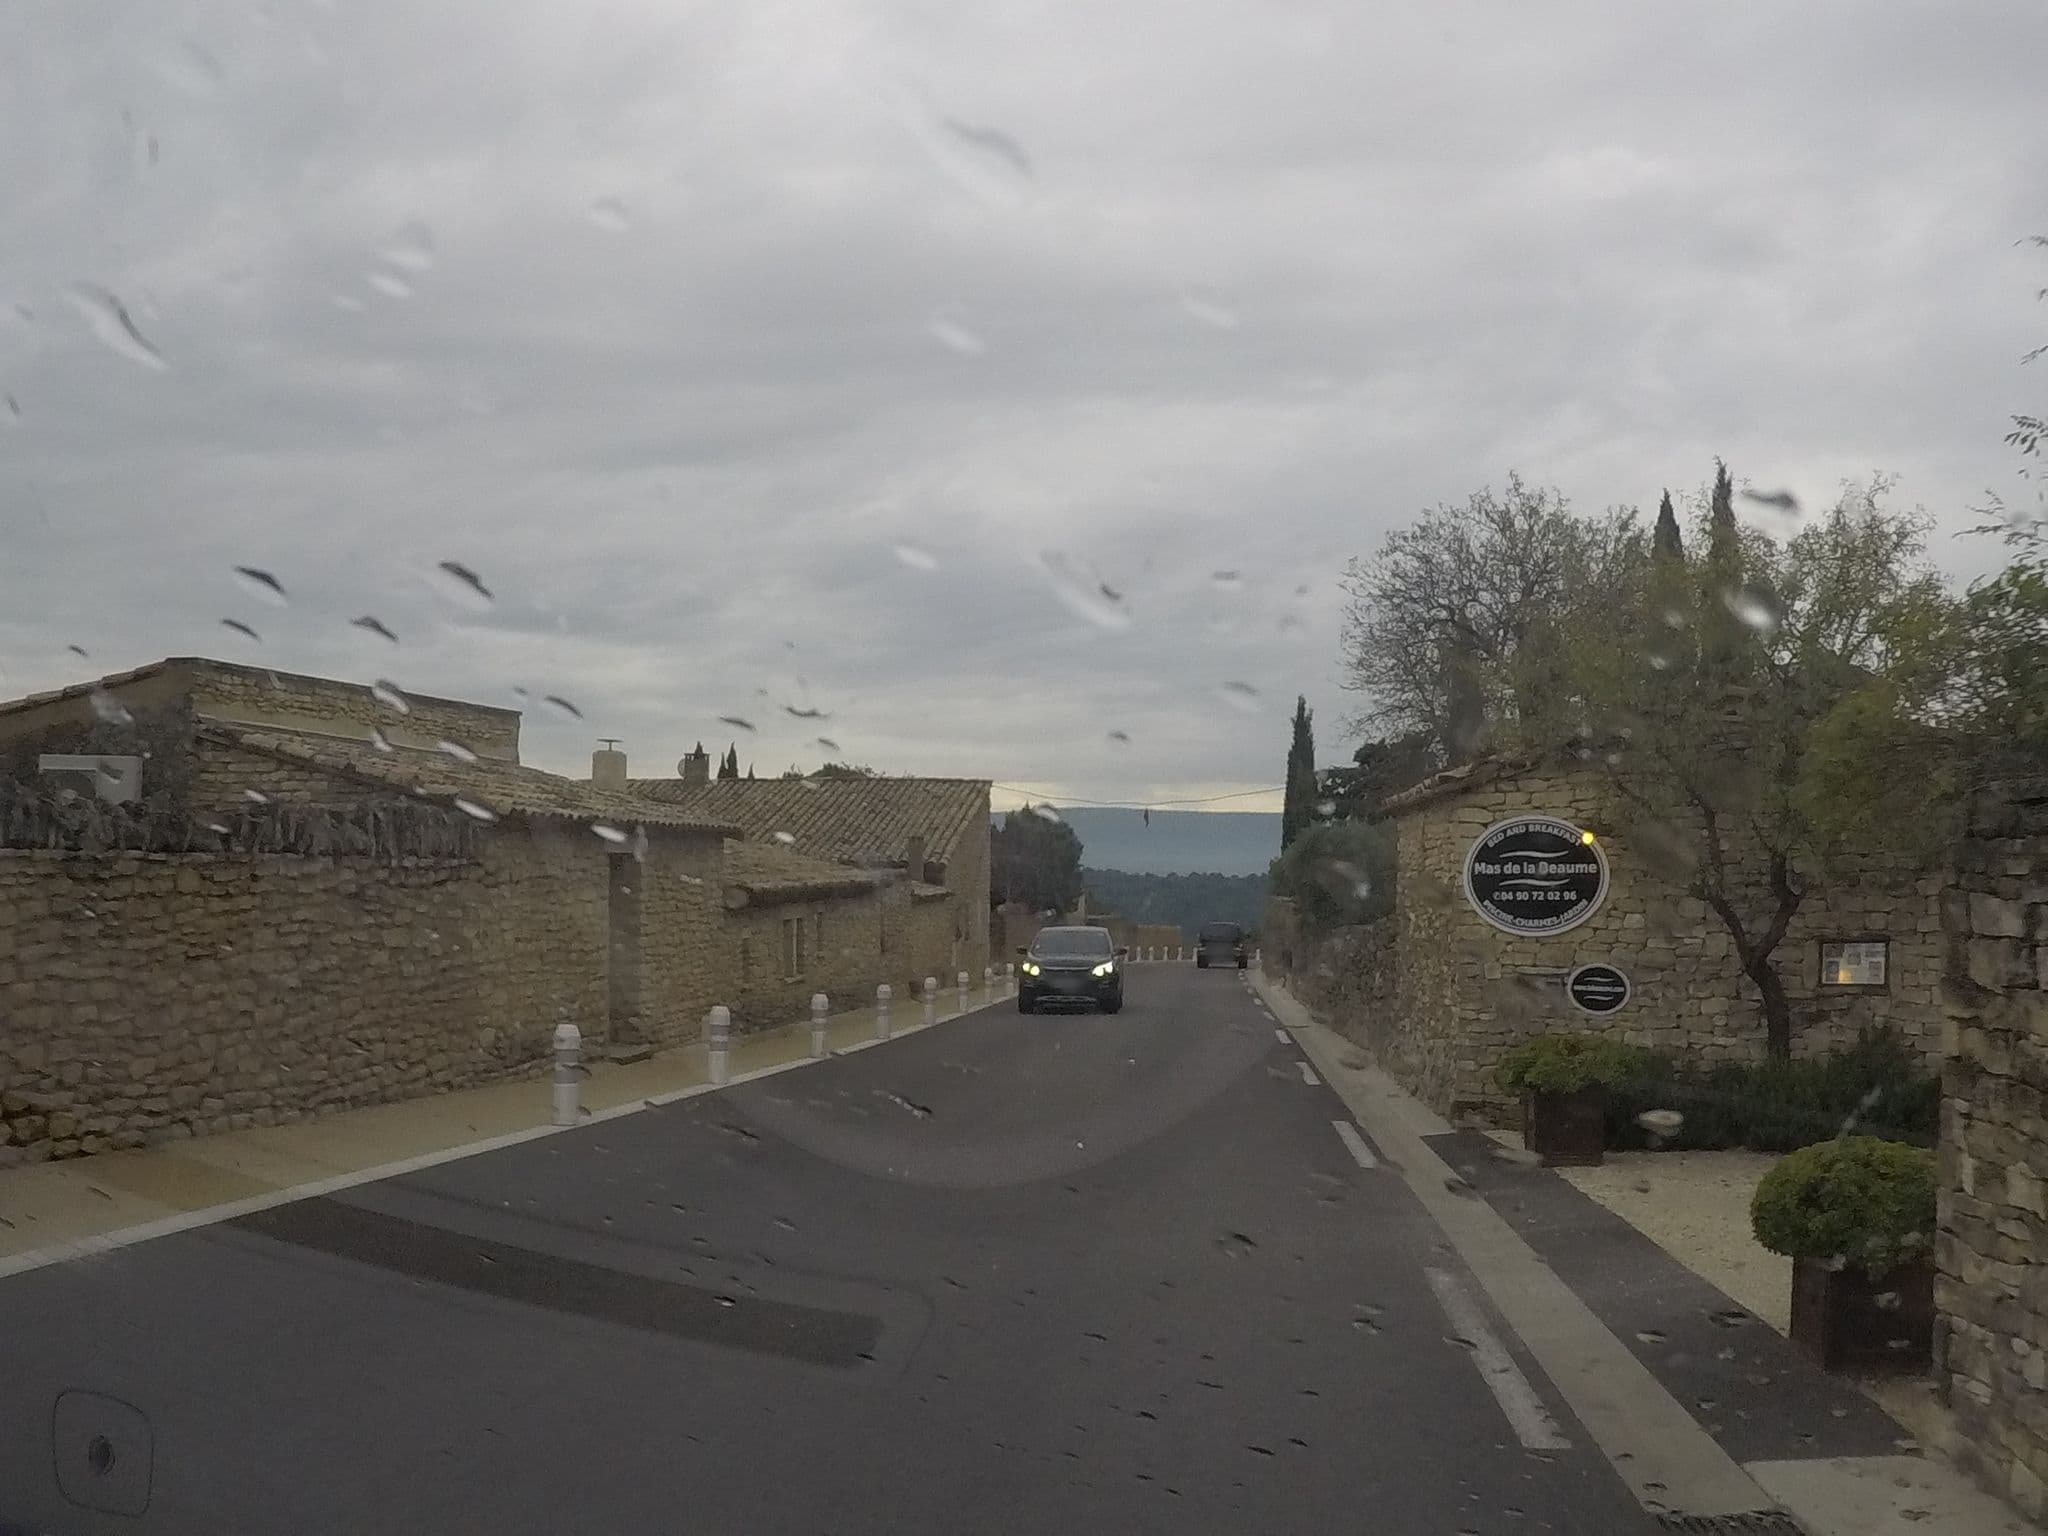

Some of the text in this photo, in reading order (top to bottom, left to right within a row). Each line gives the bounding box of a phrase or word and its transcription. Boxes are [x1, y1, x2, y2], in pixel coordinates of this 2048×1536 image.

[1486, 833, 1505, 848] BED
[1506, 825, 1526, 837] AND
[1474, 861, 1597, 874] Mas de la Beaume
[1532, 891, 1545, 900] 72
[1563, 891, 1577, 901] 96
